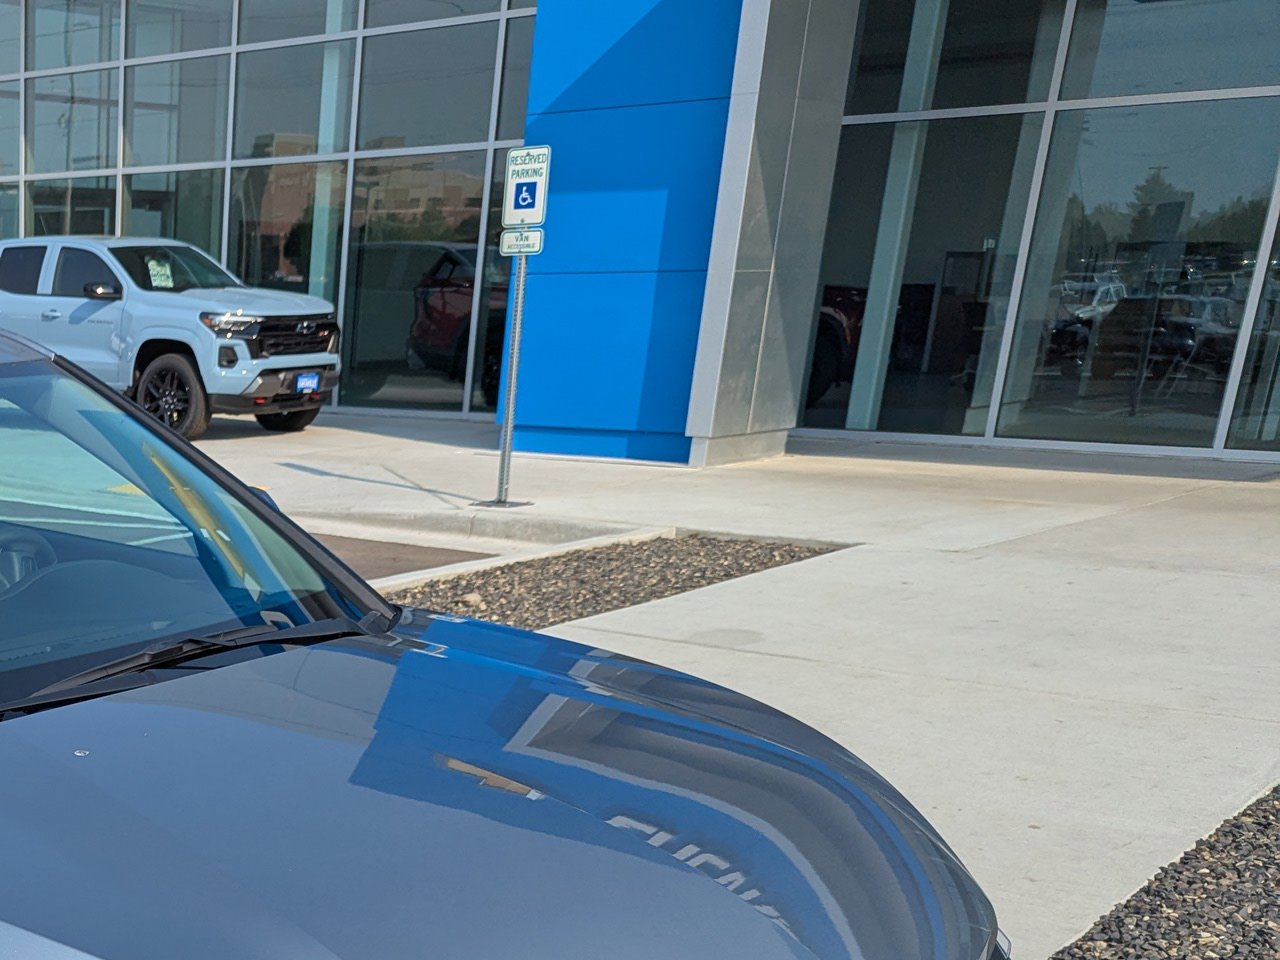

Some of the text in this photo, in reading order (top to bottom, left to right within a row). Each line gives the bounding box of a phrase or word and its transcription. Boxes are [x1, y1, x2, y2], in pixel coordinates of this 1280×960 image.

[510, 153, 547, 166] RESERVED
[511, 167, 544, 179] PARKING
[514, 235, 529, 243] VAN
